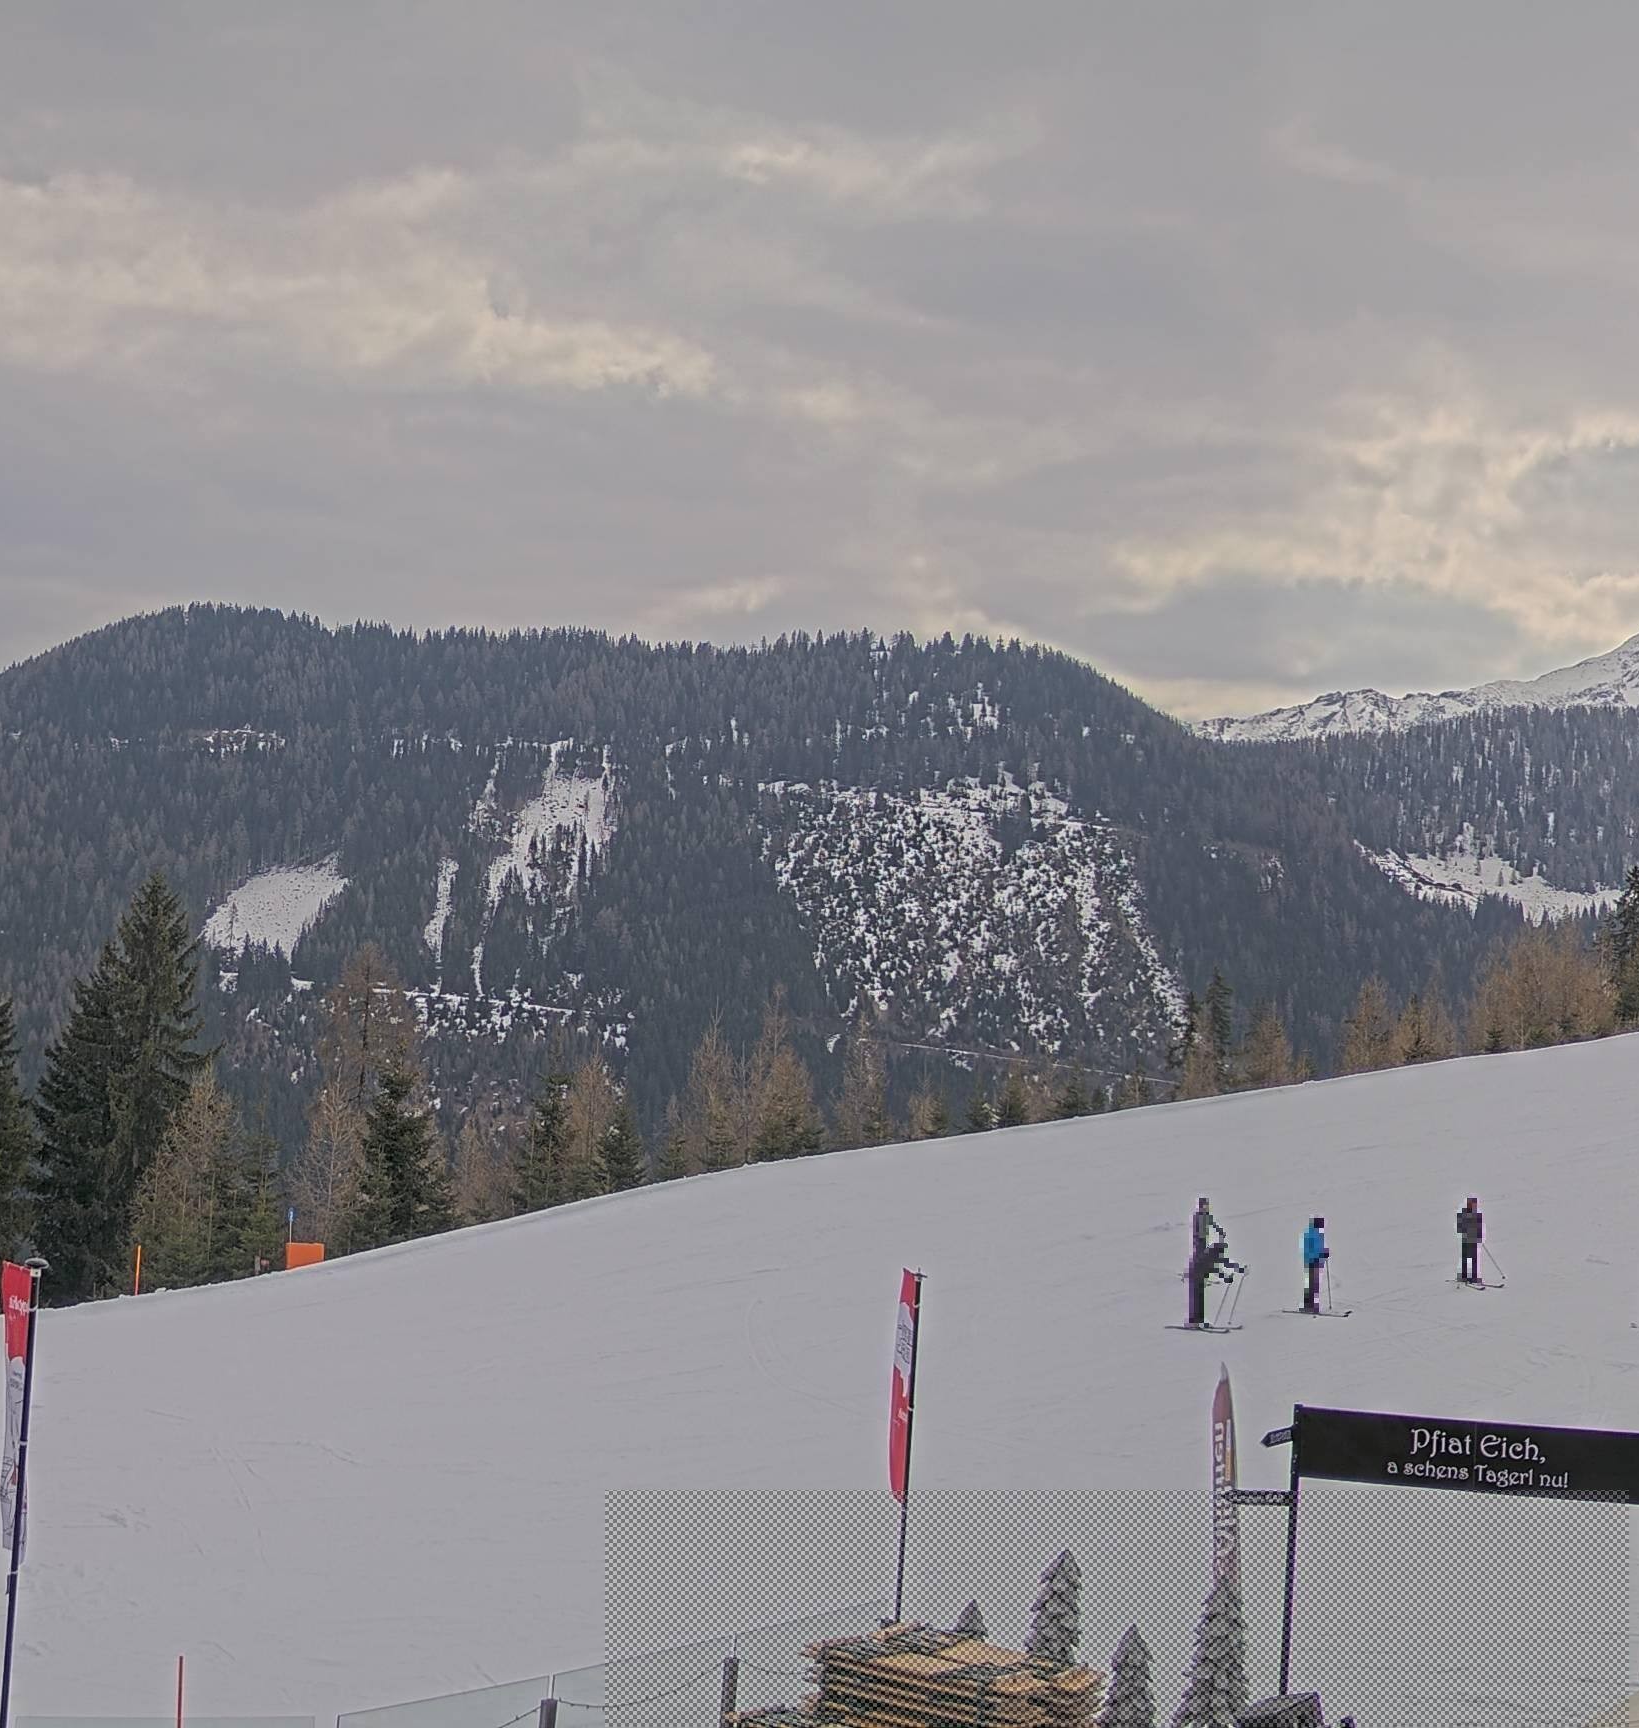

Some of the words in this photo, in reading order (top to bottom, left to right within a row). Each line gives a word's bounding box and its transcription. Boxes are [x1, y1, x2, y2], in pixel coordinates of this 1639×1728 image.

[1410, 1428, 1471, 1457] Pfiat
[1480, 1434, 1546, 1464] Eich,
[1387, 1461, 1398, 1474] a
[1403, 1460, 1469, 1481] schens
[1473, 1464, 1534, 1488] Tagerl
[1539, 1471, 1569, 1489] nu!
